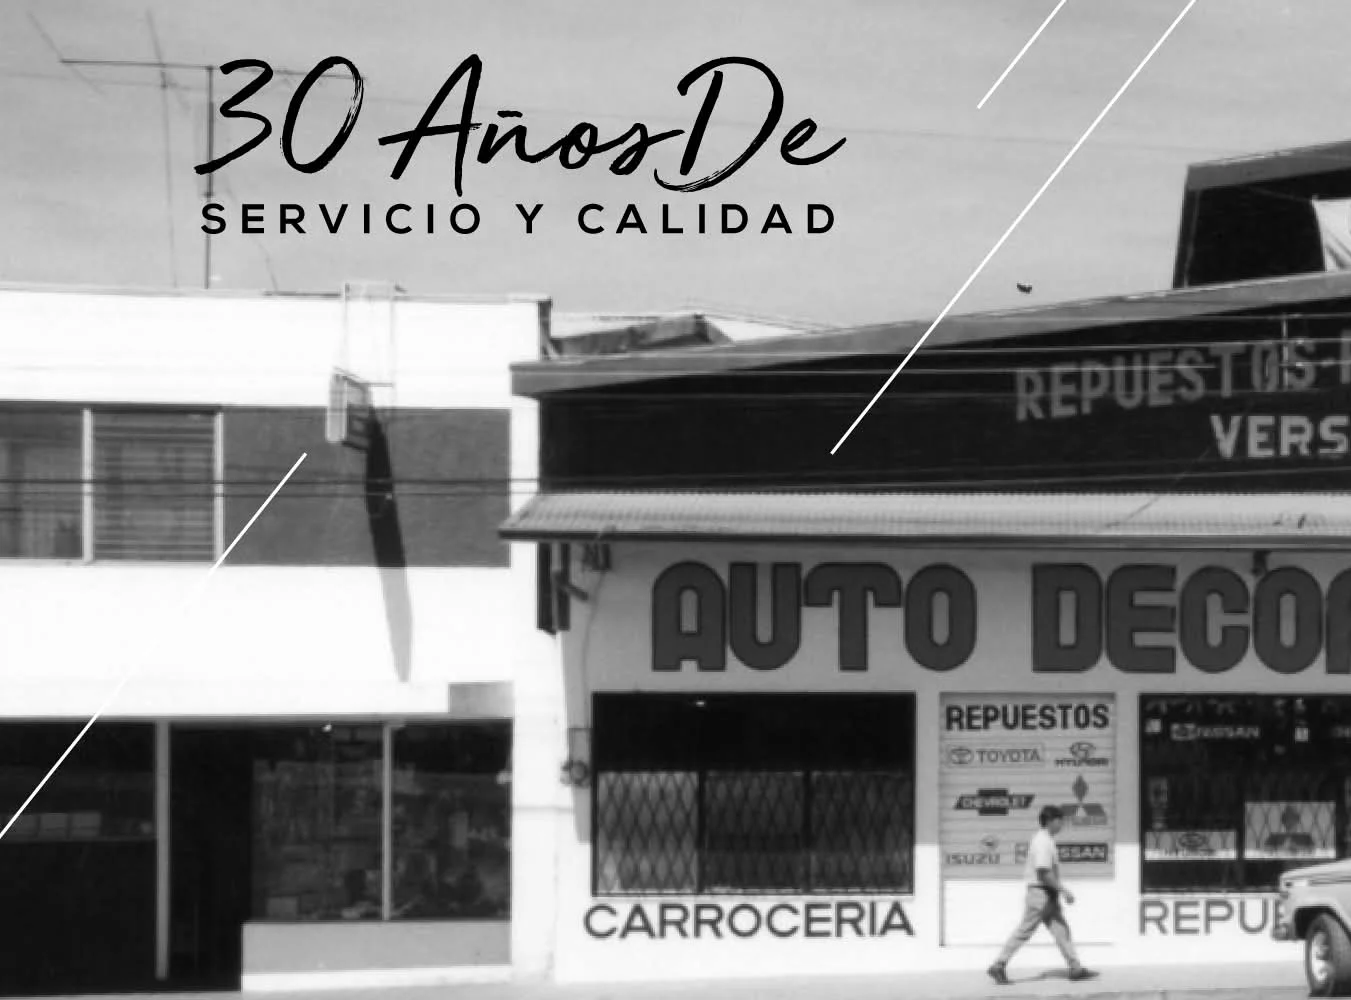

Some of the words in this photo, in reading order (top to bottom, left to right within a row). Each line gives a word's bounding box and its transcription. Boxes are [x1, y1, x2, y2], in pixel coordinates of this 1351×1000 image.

[651, 561, 978, 673] AUTO
[945, 703, 1110, 732] REPUESTOS
[976, 748, 1042, 764] TOYOTA
[946, 852, 1000, 864] ISUZU
[583, 900, 915, 939] CARROCERIA
